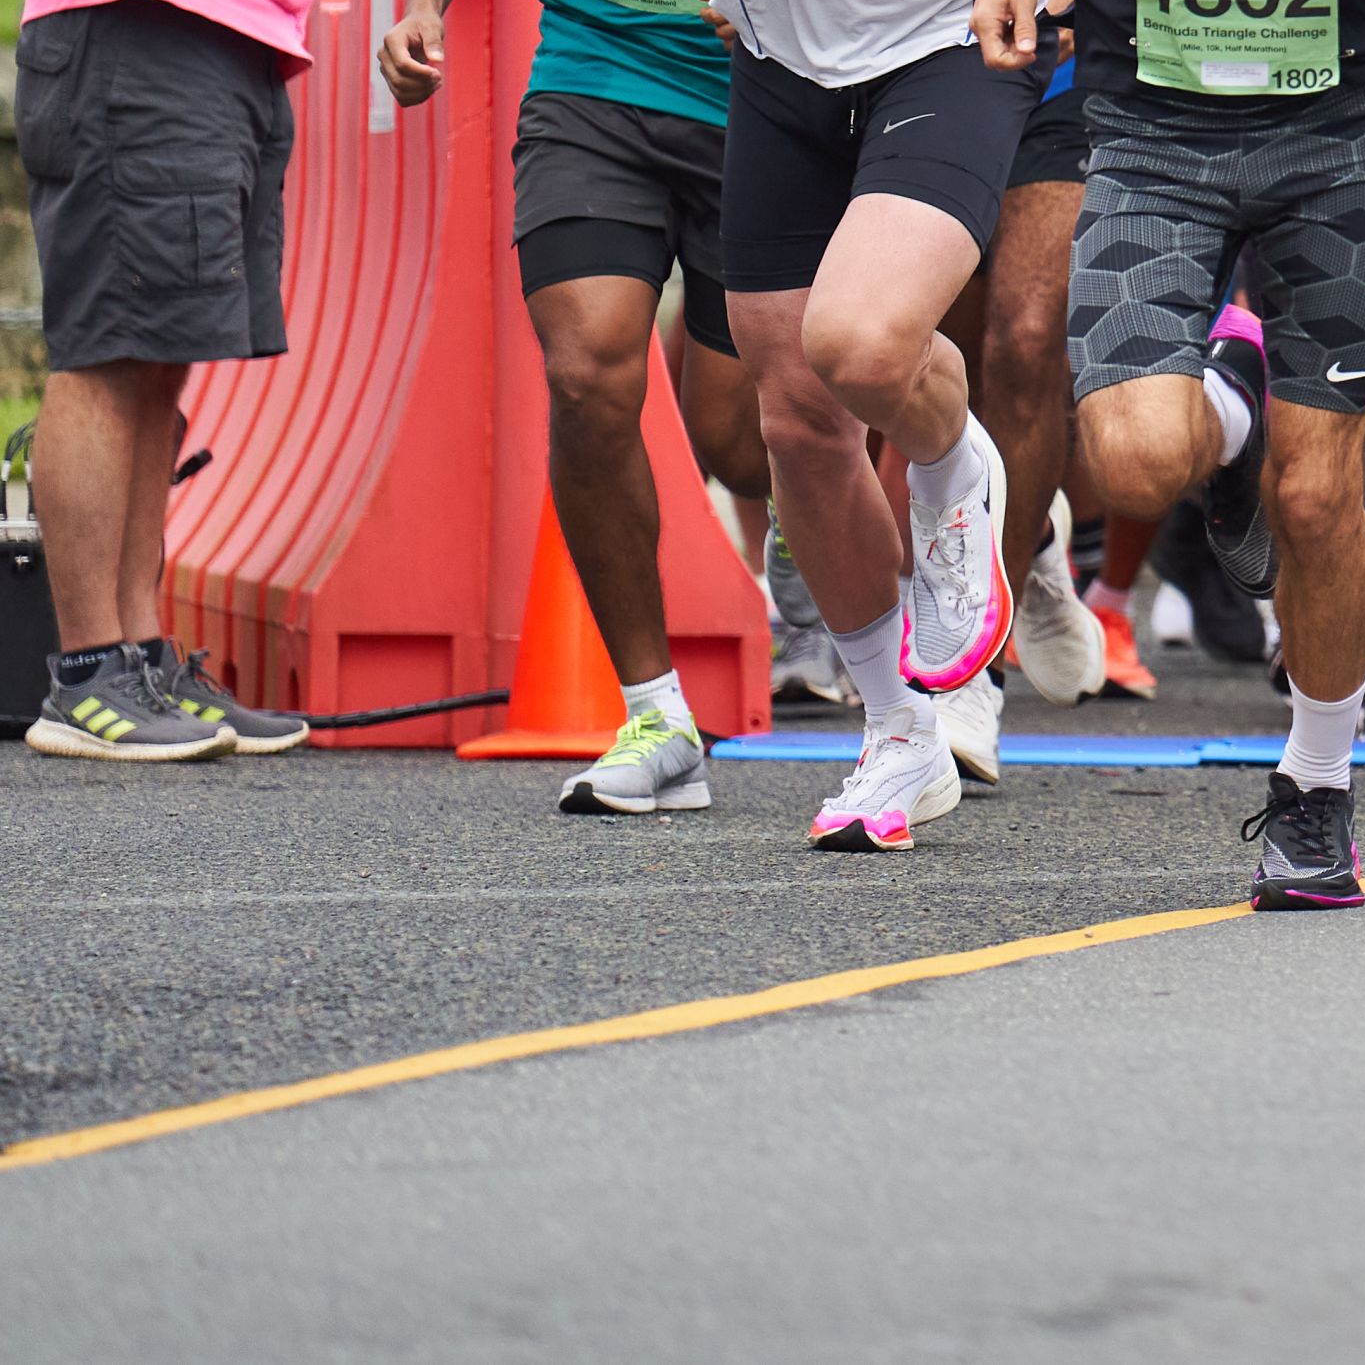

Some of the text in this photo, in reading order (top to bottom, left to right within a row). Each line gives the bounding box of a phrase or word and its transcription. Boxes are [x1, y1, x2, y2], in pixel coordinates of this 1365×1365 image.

[1143, 17, 1328, 40] Bermuda Triangle Challenge
[1225, 44, 1242, 52] Half
[1244, 45, 1287, 53] Marathon)
[1271, 68, 1334, 90] 1802
